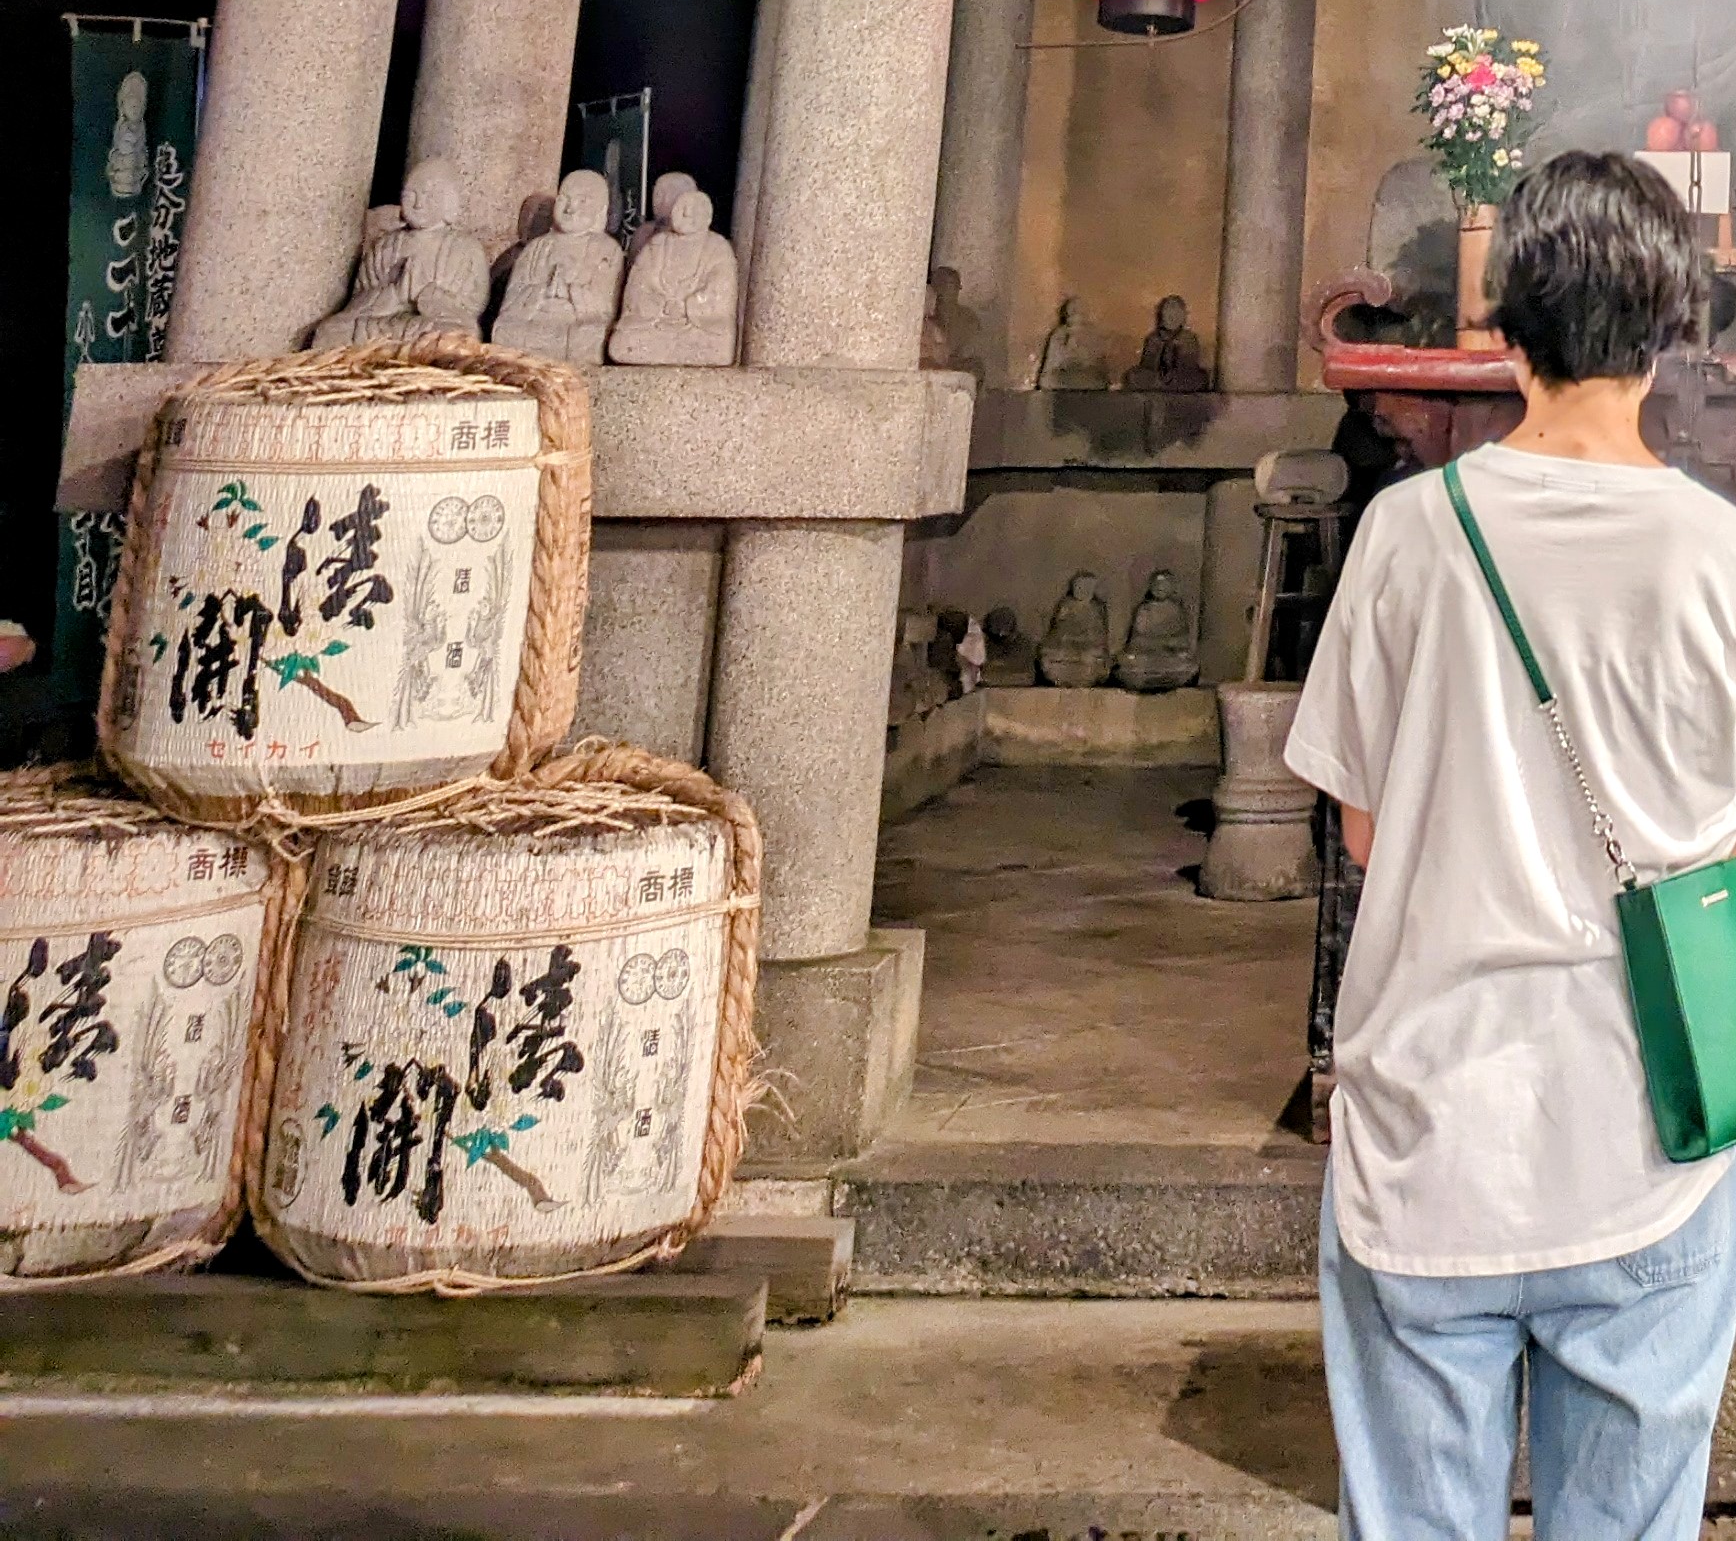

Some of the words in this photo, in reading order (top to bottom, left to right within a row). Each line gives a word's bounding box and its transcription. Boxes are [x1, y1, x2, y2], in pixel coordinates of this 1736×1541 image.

[450, 419, 512, 452] 商標
[206, 739, 321, 760] セイカイ
[186, 845, 250, 882] 商標
[637, 865, 694, 904] 商標
